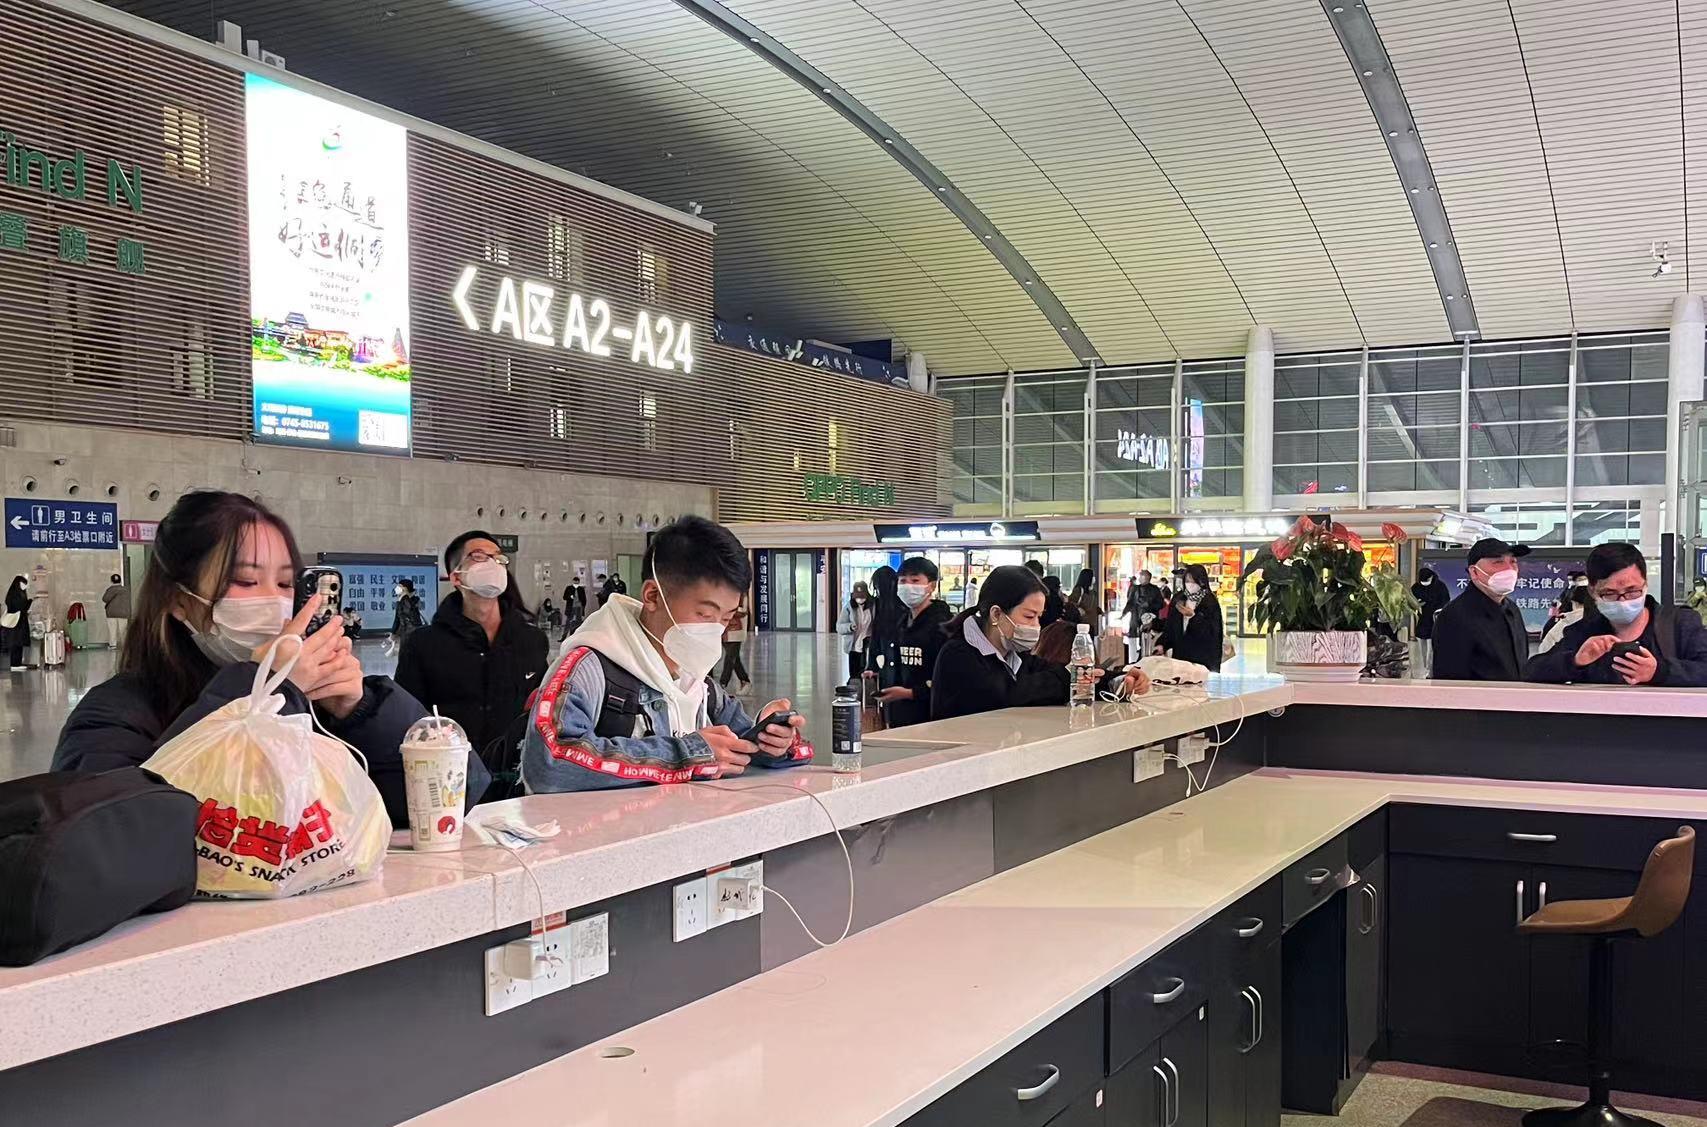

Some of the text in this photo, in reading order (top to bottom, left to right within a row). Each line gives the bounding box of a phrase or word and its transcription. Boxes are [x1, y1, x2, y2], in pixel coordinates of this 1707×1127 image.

[0, 130, 142, 214] ind N
[491, 276, 694, 374] A区 A2-A24
[54, 509, 113, 526] 男卫生间
[31, 529, 114, 544] 请前行至A3检票口附近
[349, 574, 364, 585] 富强
[370, 574, 385, 585] 民主
[1516, 577, 1565, 589] 牢记使命
[349, 588, 365, 598] 自由
[370, 588, 385, 598] 平等
[370, 601, 385, 611] 敬业
[249, 866, 296, 883] SNACK
